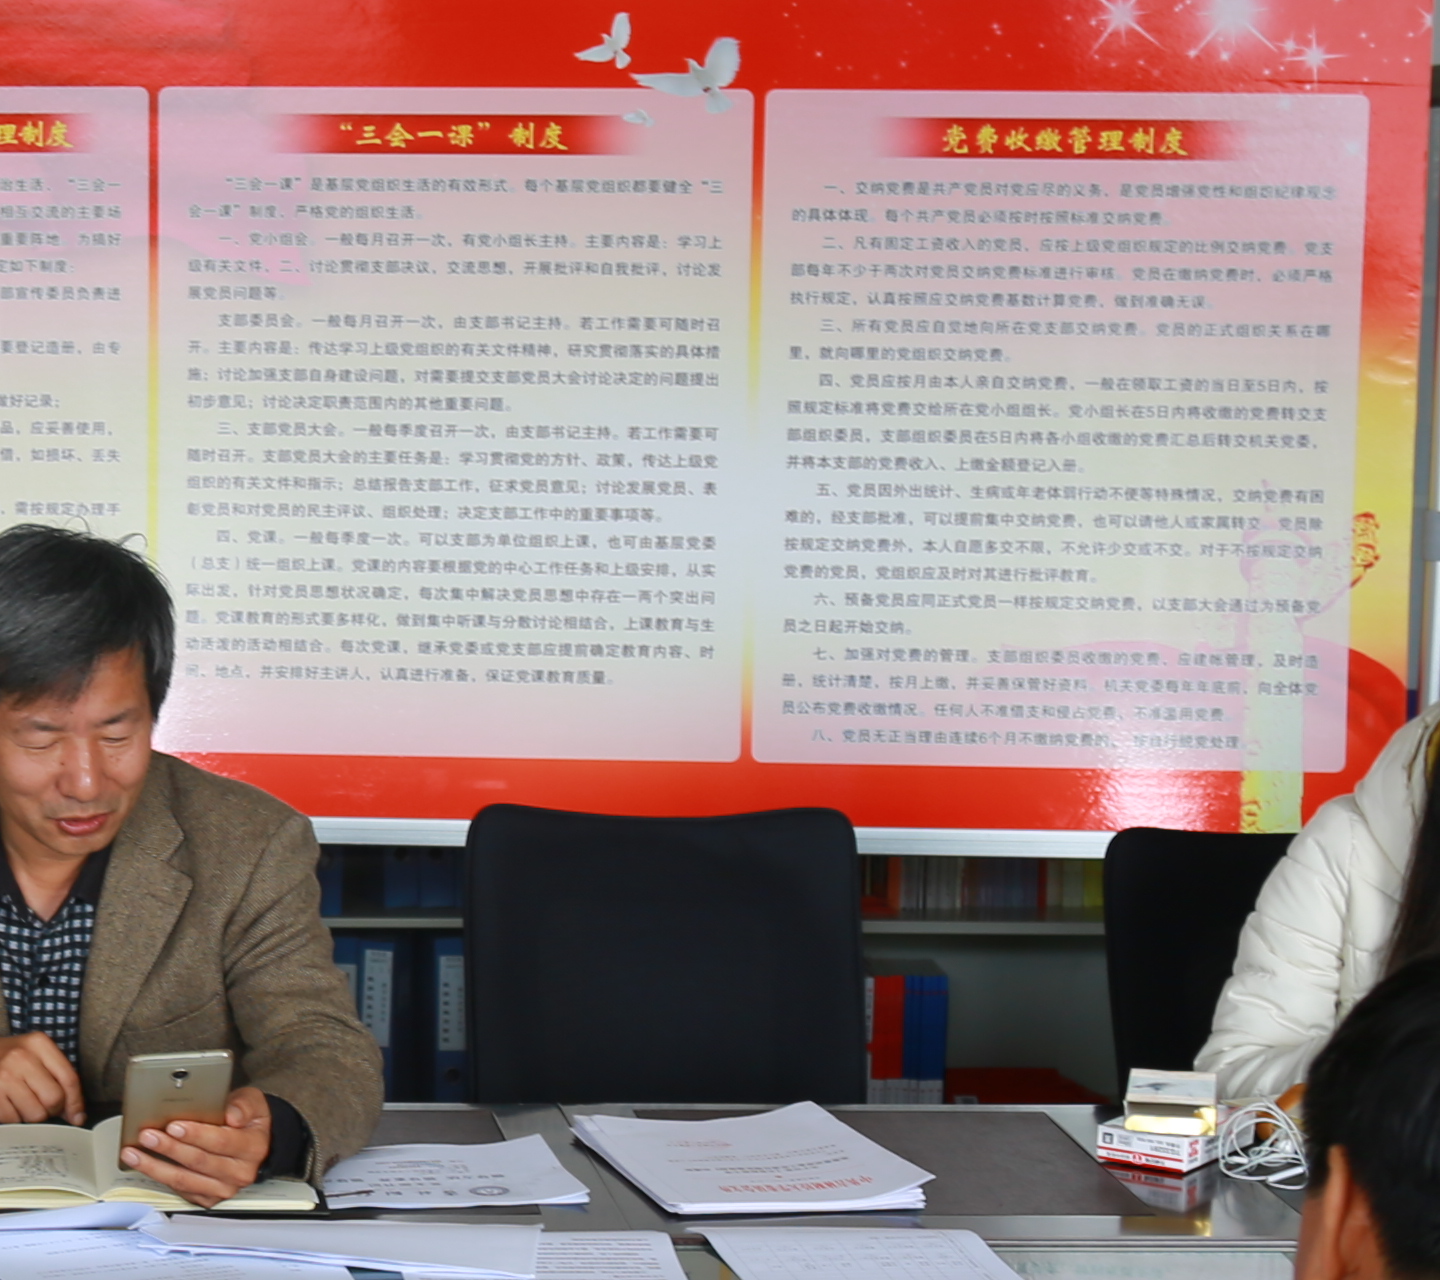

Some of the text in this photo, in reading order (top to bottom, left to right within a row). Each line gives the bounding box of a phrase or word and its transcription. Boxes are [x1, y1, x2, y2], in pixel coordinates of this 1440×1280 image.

[340, 121, 568, 150] “三会一课”制度
[942, 123, 1189, 154] 党费收缴管理制度
